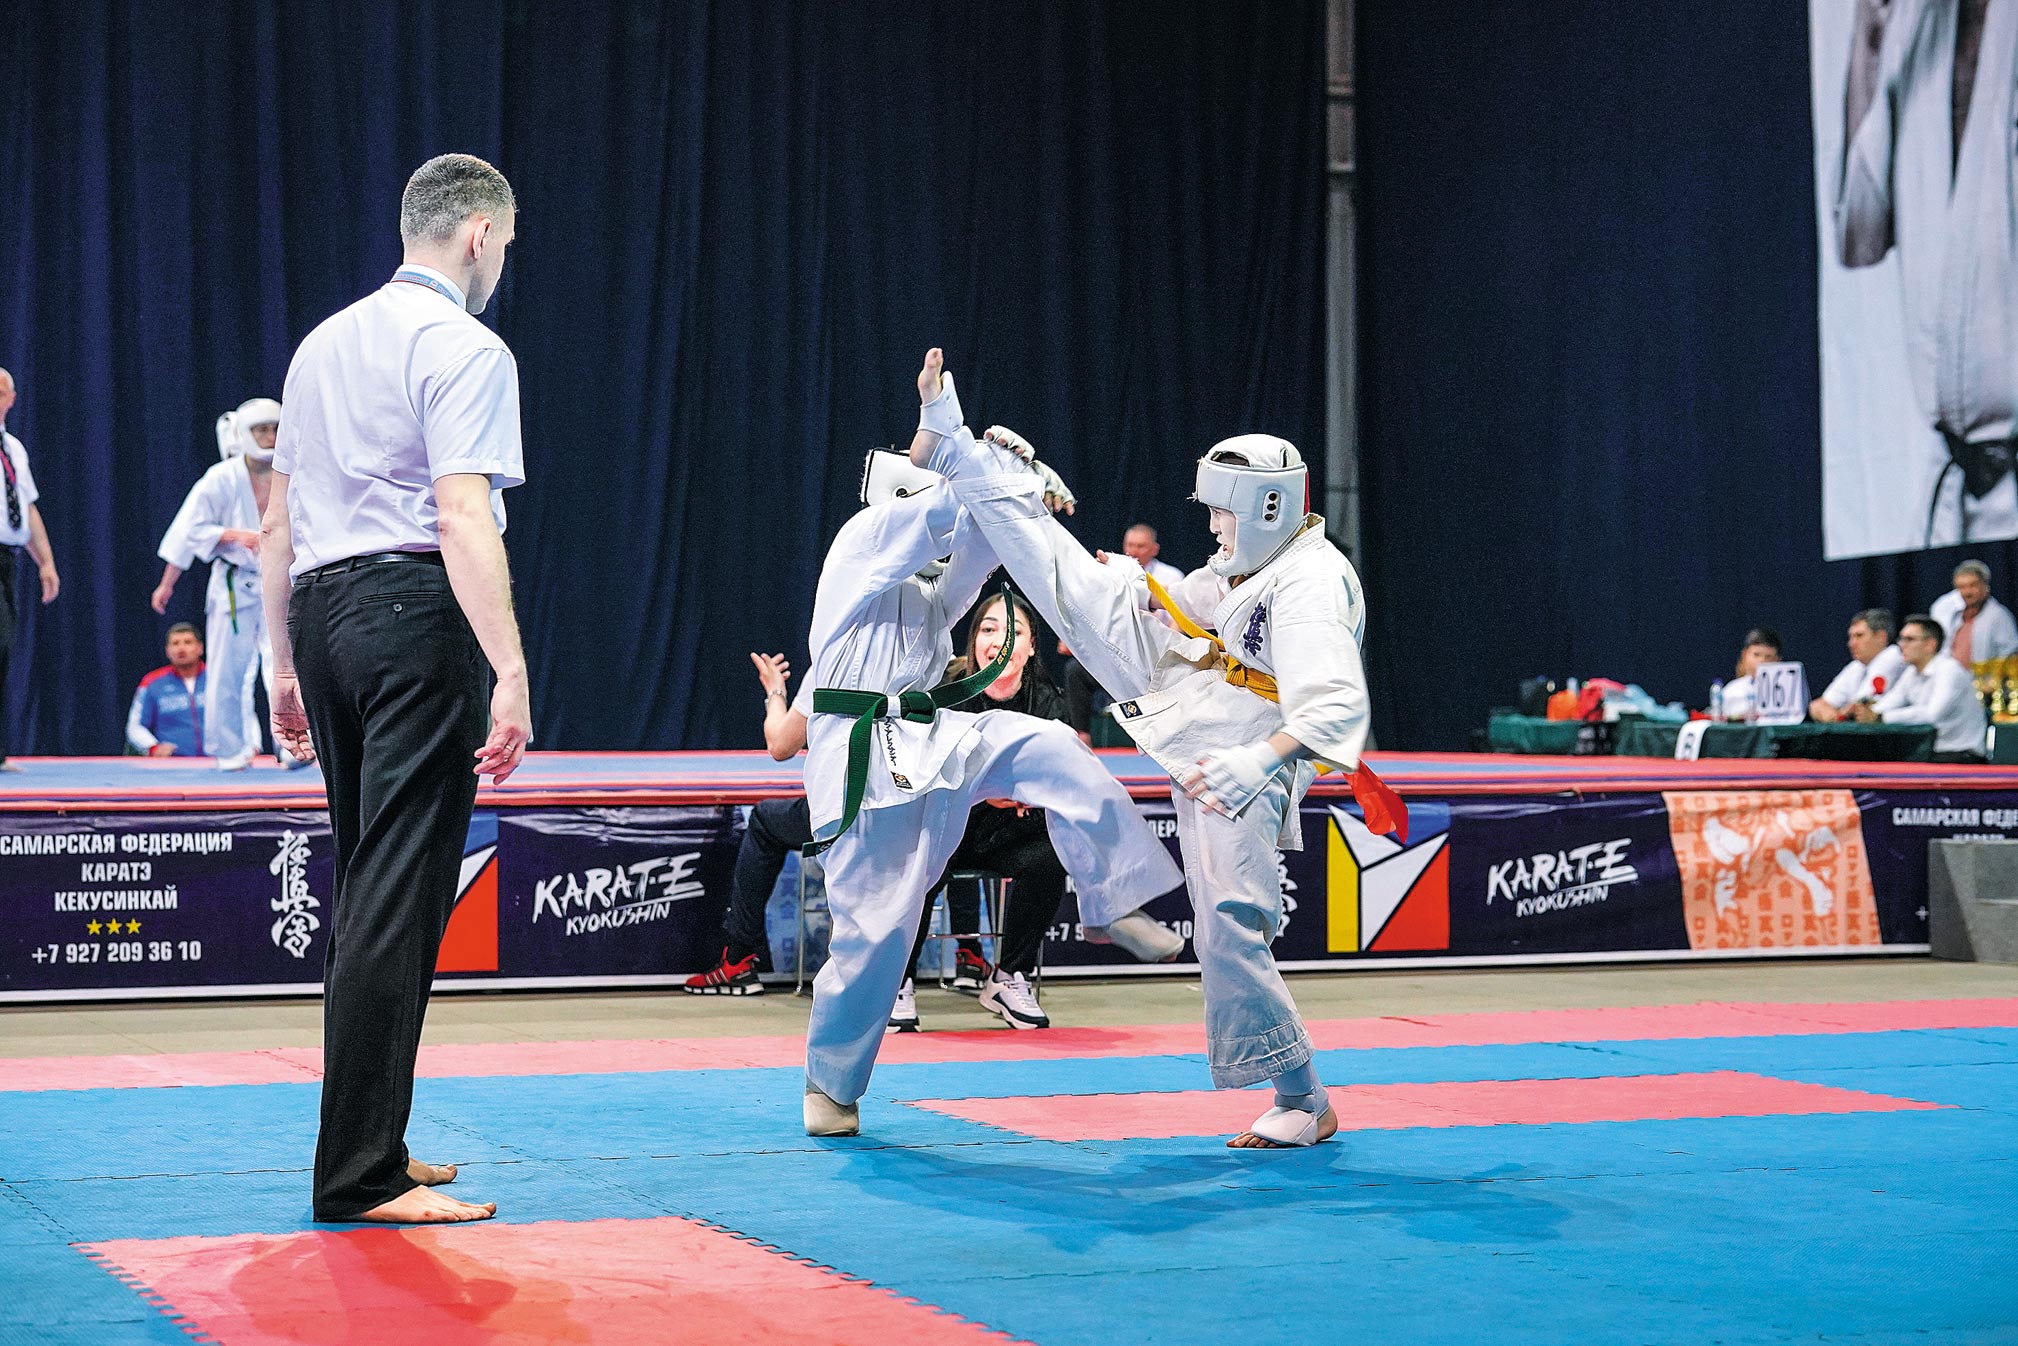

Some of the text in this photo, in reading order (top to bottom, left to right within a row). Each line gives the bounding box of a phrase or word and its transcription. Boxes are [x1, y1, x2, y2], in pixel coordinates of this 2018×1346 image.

[1757, 668, 1798, 708] 067
[0, 832, 233, 855] САМАРСКАЯ ФЕДЕРАЦИЯ
[81, 862, 152, 882] КАРАТЭ
[1486, 838, 1637, 906] KARATE
[54, 884, 178, 911] КЕКУСИНКАЙ
[532, 852, 704, 924] KARATE
[1516, 885, 1610, 918] KYOKUSHIN
[566, 901, 671, 936] KYOKUSHIN
[1045, 922, 1070, 942] +7
[31, 940, 202, 964] +7 927 209 36 10
